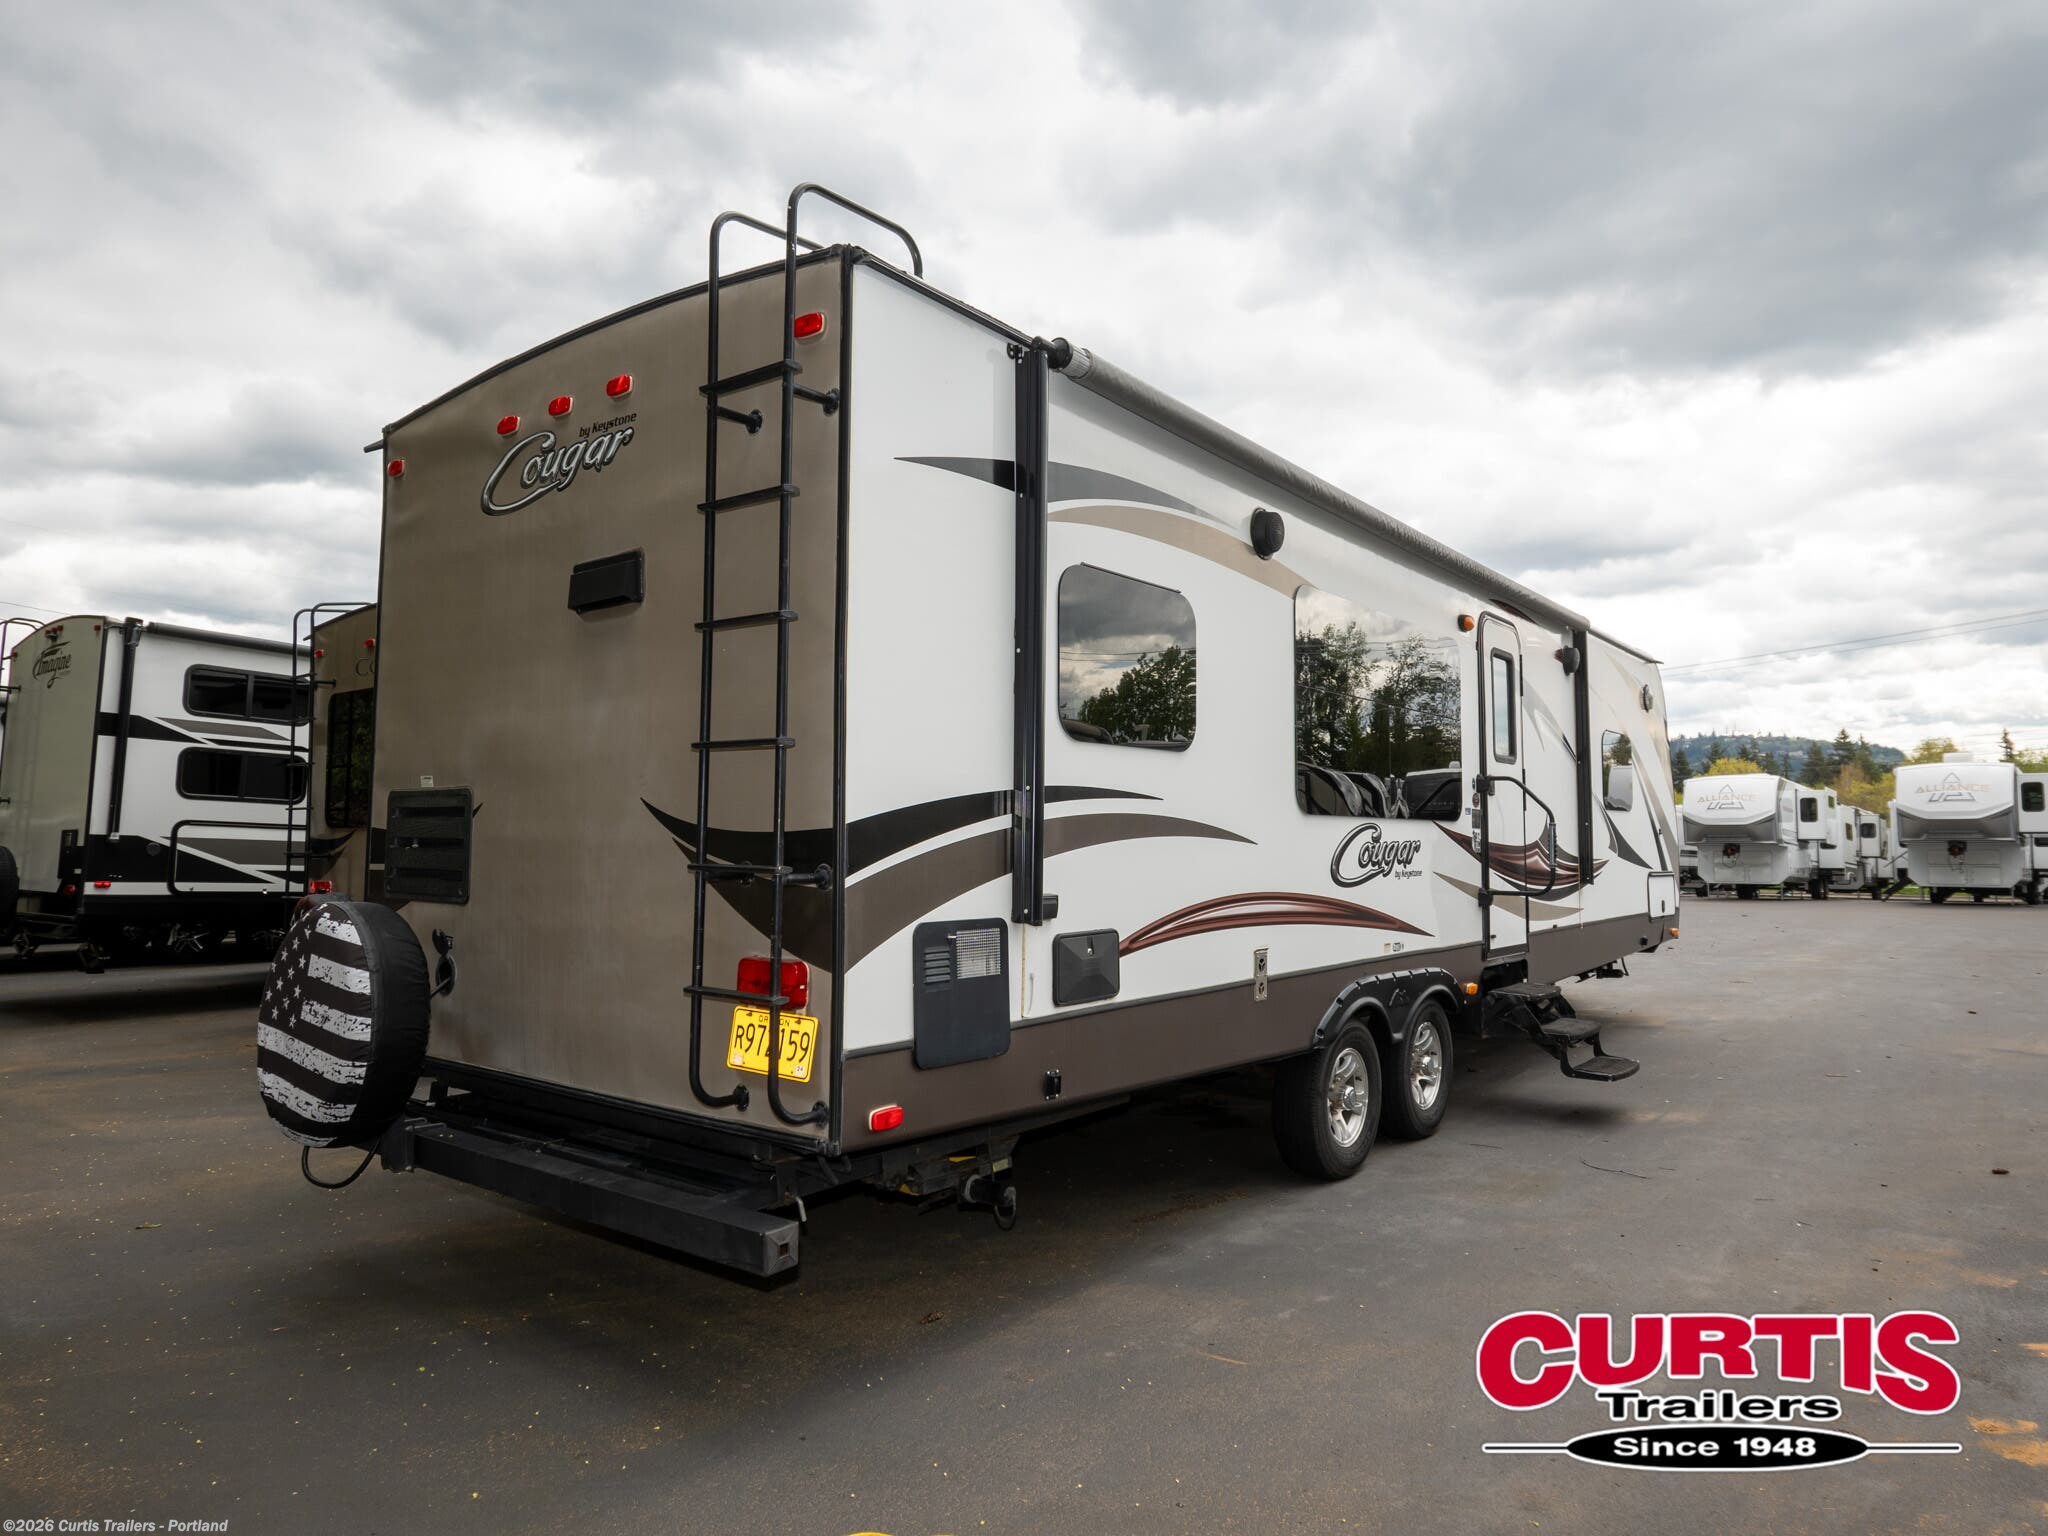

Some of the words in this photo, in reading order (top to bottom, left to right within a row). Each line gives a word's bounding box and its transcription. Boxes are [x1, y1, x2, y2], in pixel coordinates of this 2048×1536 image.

[579, 426, 591, 439] by
[592, 412, 637, 434] Keystone
[480, 426, 634, 516] Cougar
[32, 640, 72, 689] Imagine
[1915, 783, 1992, 794] ALLIANCE
[1330, 822, 1421, 888] Cougar
[758, 1014, 791, 1027] ORON
[734, 1023, 810, 1063] R97159
